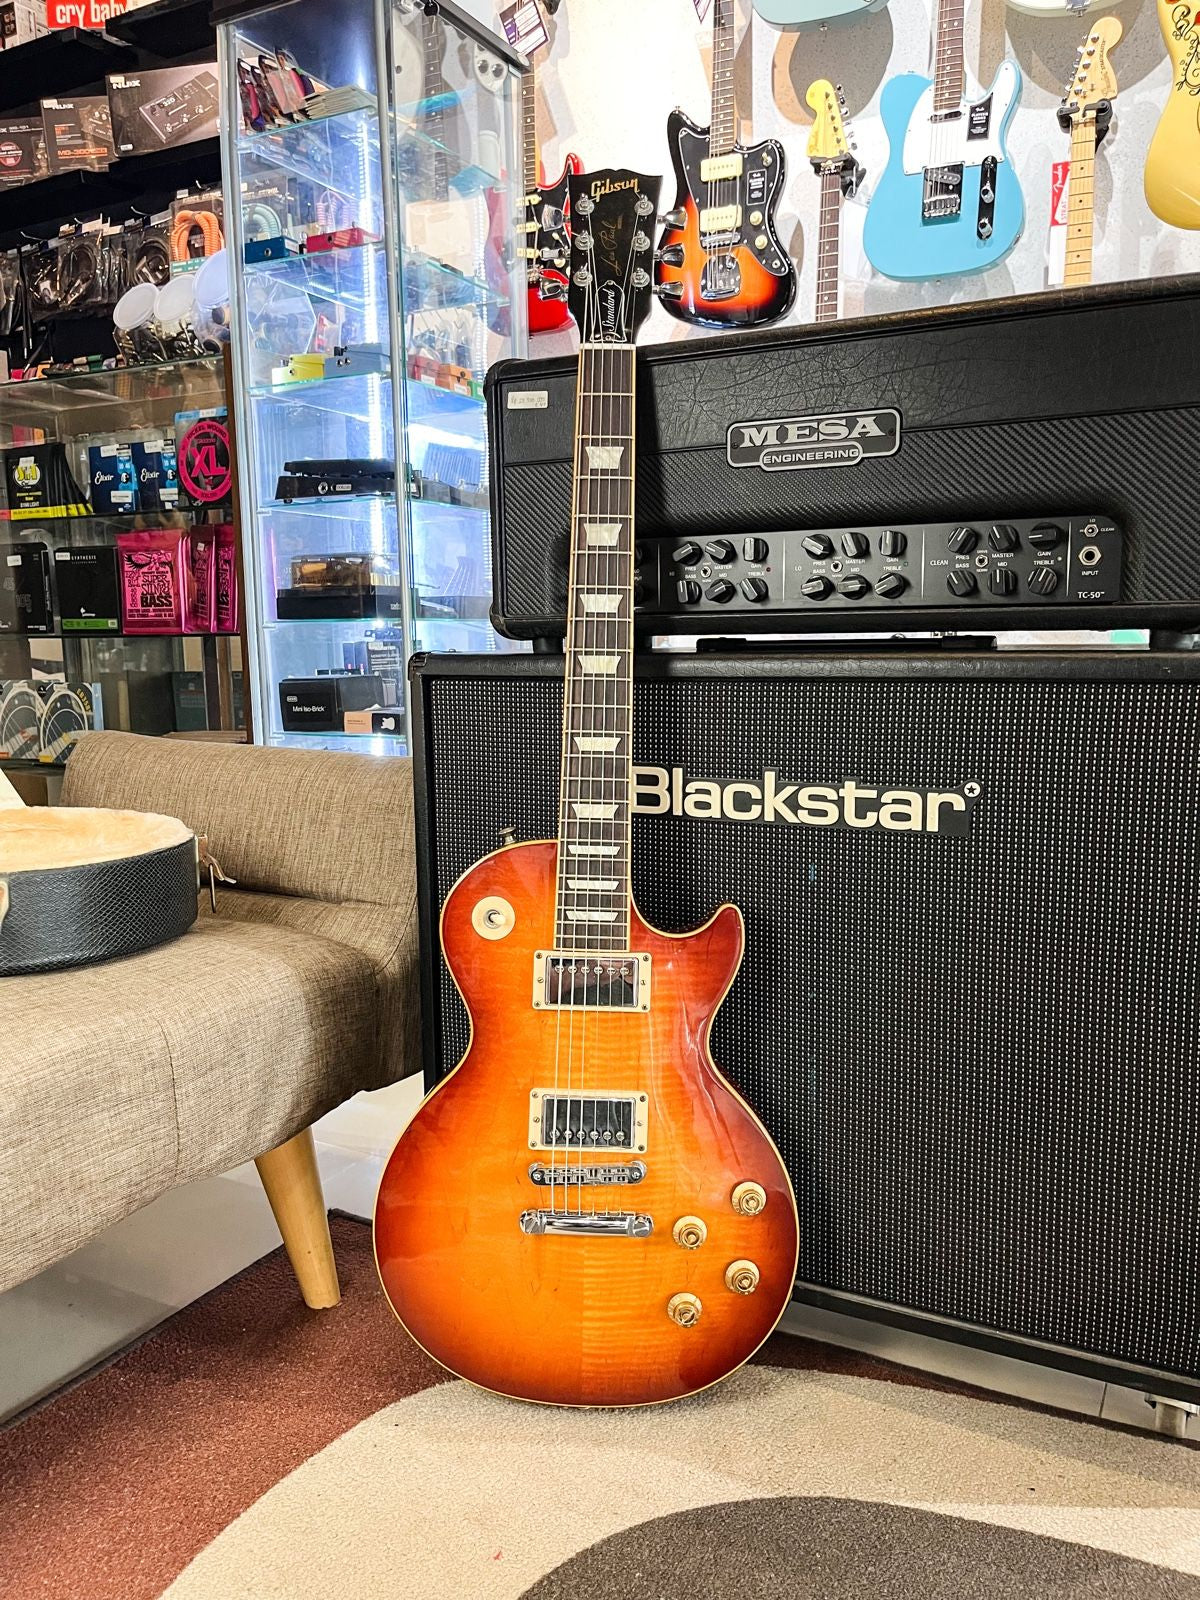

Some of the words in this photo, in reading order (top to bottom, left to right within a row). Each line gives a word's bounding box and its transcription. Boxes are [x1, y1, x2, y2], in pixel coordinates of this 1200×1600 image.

[56, 4, 86, 28] cry
[590, 178, 640, 202] Gibson
[602, 288, 616, 332] Standard
[739, 416, 886, 448] MESA
[190, 445, 226, 478] XL
[764, 448, 859, 464] ENGINEERING
[94, 471, 114, 484] Elixir
[140, 468, 160, 482] Elixir
[142, 574, 168, 582] SUPER
[141, 582, 170, 596] SLINKY
[140, 596, 172, 607] BASS
[632, 766, 966, 832] Blackstar
